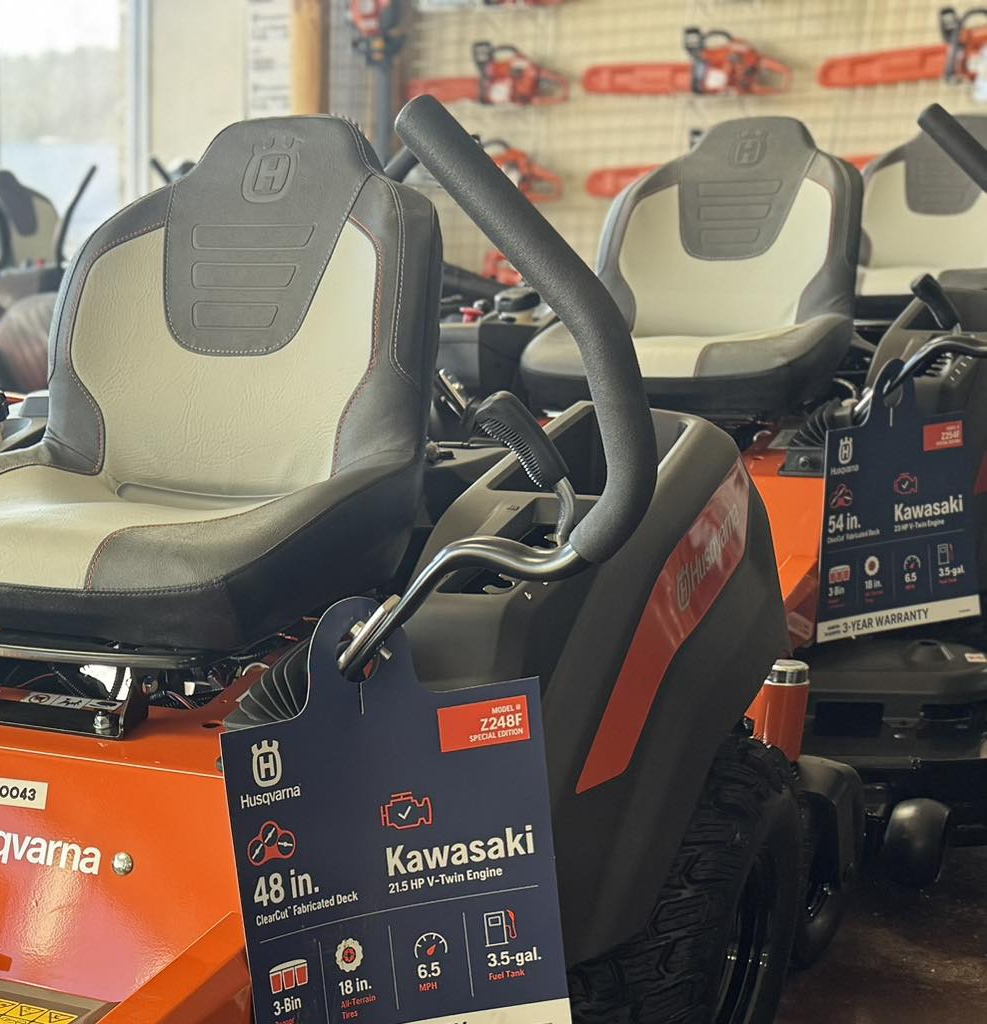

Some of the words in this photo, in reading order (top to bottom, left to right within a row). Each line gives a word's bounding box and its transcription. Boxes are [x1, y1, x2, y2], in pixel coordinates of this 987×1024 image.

[894, 494, 963, 522] Kawasaki
[828, 513, 844, 533] 54
[846, 512, 861, 530] in.
[865, 580, 873, 590] 18
[904, 572, 917, 583] 6.5
[842, 619, 873, 634] 3-YEAR
[875, 608, 929, 627] WARRANTY
[491, 705, 514, 714] MODEL
[480, 713, 523, 732] Z248F
[469, 731, 497, 742] SPECIAL
[498, 727, 524, 738] EDITION
[240, 786, 301, 809] Husqvarna
[386, 825, 535, 877] Kawasaki
[253, 872, 285, 907] 48
[290, 869, 319, 899] in.
[388, 880, 409, 894] 21.5
[410, 879, 425, 891] HP
[427, 872, 465, 887] V-Twin
[467, 867, 503, 882] Engine
[293, 896, 334, 916] Fabricated
[336, 891, 358, 905] Deck
[486, 946, 542, 967] 3.5-gal.
[417, 962, 441, 979] 6.5
[488, 972, 504, 981] Fuel
[506, 969, 525, 978] Tank
[338, 980, 353, 996] 18
[355, 978, 372, 992] in.
[419, 981, 438, 992] MPH
[273, 996, 302, 1016] 3-Bin
[341, 994, 376, 1009] All-Terrain
[342, 1010, 358, 1020] Tires
